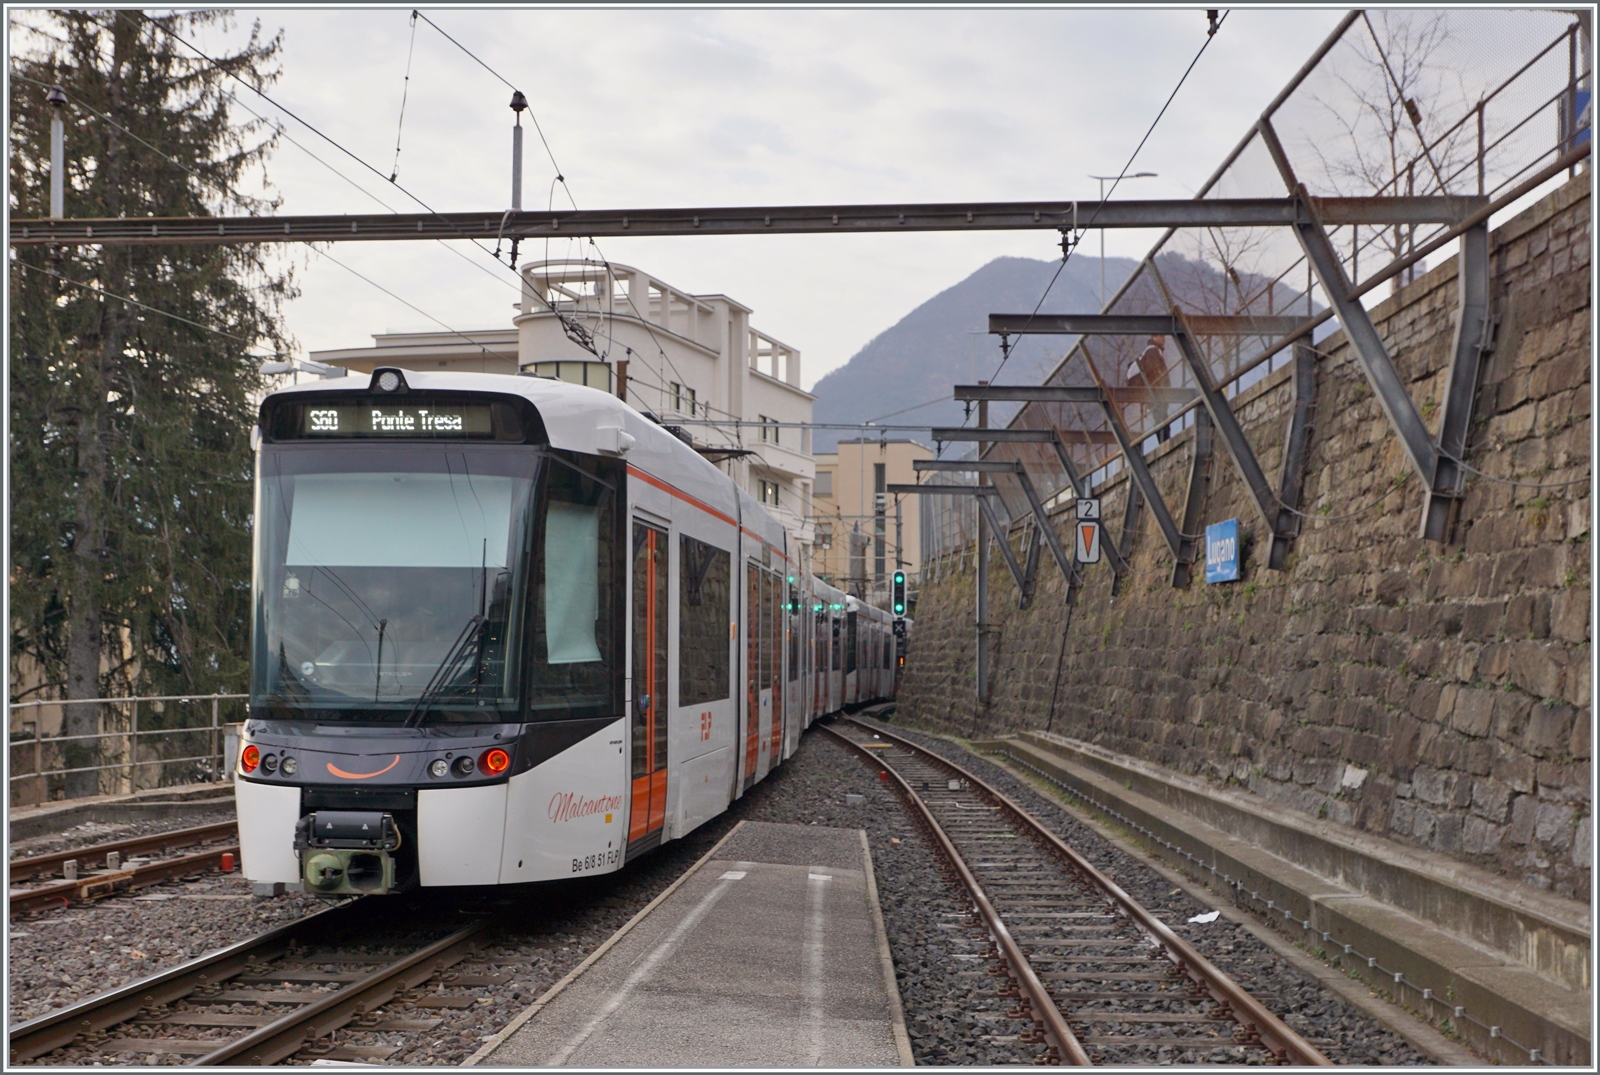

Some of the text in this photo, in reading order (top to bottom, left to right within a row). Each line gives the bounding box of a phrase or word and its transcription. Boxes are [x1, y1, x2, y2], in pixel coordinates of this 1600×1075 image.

[310, 410, 462, 430] S60 Ponte Tresa
[1084, 501, 1093, 517] 2
[1207, 535, 1235, 572] Lugano
[548, 791, 622, 824] Malcantone
[572, 849, 619, 873] Be 6/8 51 FLP
